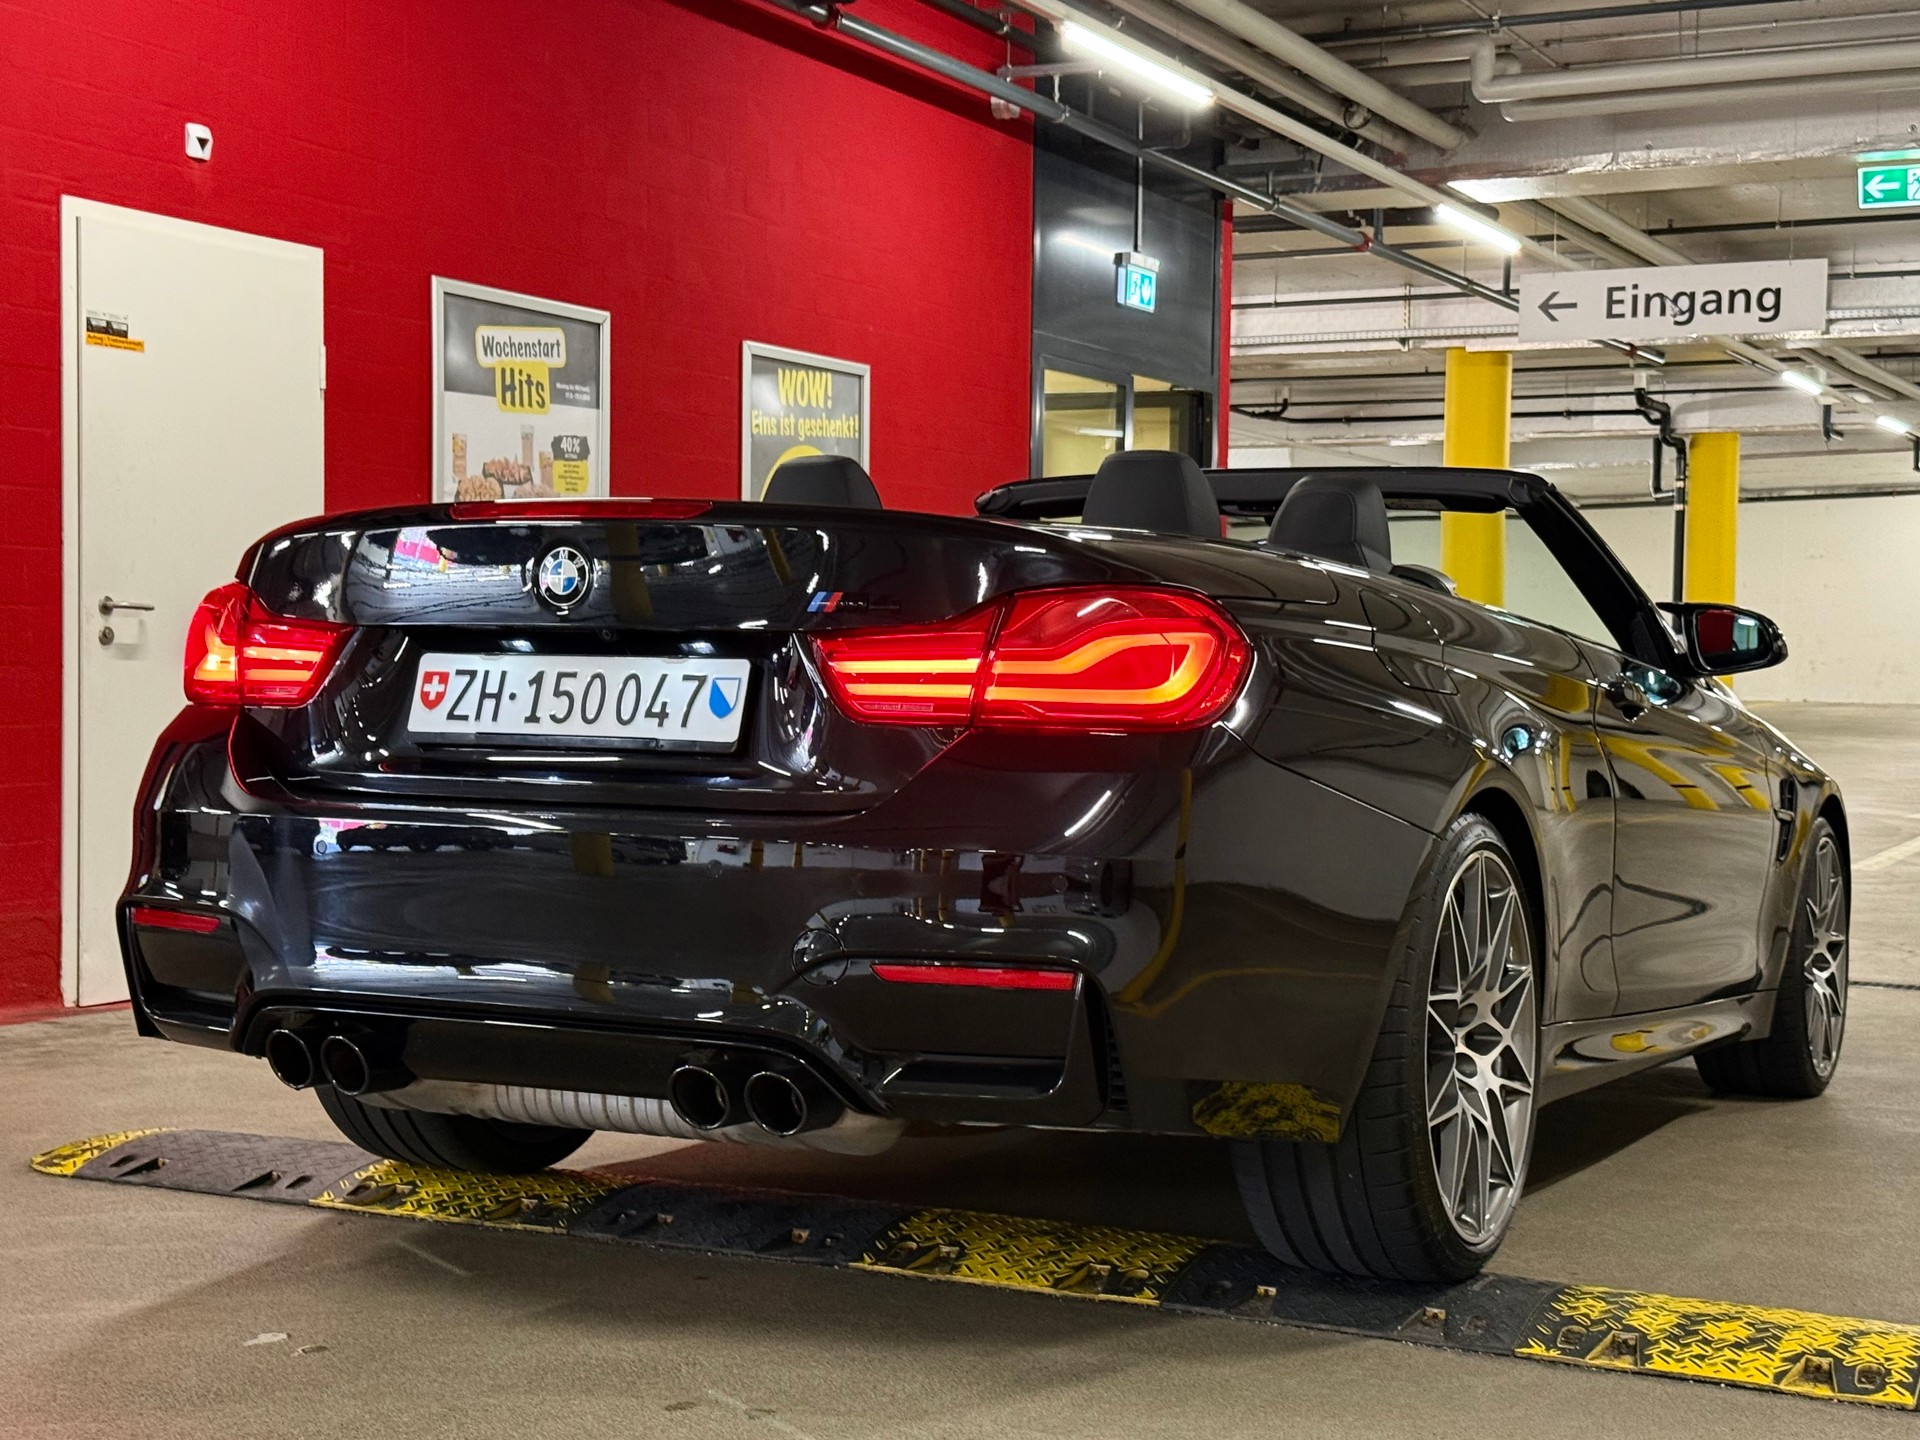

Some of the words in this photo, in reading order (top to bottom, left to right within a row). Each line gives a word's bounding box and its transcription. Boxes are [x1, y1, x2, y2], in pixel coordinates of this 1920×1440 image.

[1605, 283, 1782, 327] Eingang
[481, 335, 561, 358] Wochenstart
[501, 367, 546, 409] Hits
[778, 367, 833, 410] WOW!
[751, 409, 777, 436] Eins
[780, 411, 796, 437] ist
[798, 411, 859, 442] geschenkt!
[560, 436, 581, 454] 40%
[544, 549, 585, 569] BMW
